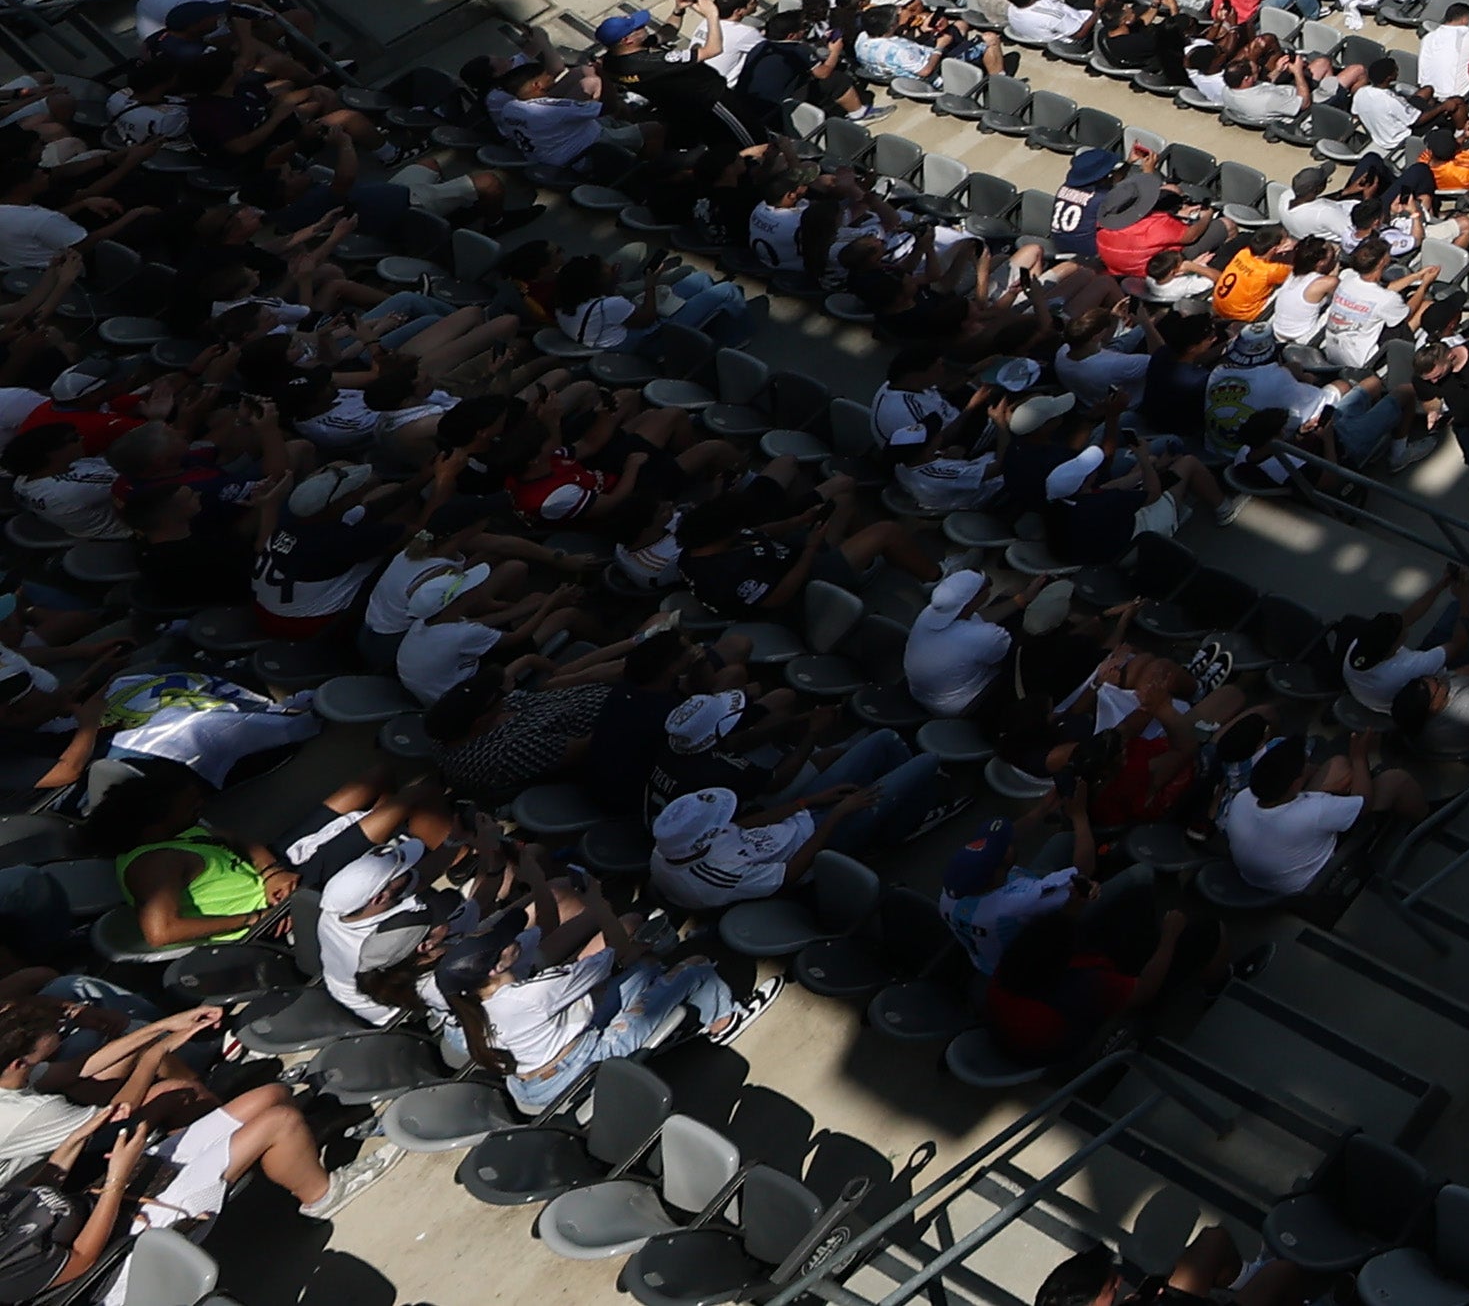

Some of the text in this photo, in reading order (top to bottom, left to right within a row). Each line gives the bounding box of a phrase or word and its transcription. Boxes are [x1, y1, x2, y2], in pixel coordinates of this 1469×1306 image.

[1051, 200, 1082, 232] 10
[1218, 274, 1237, 299] 9
[651, 763, 680, 794] TRENT
